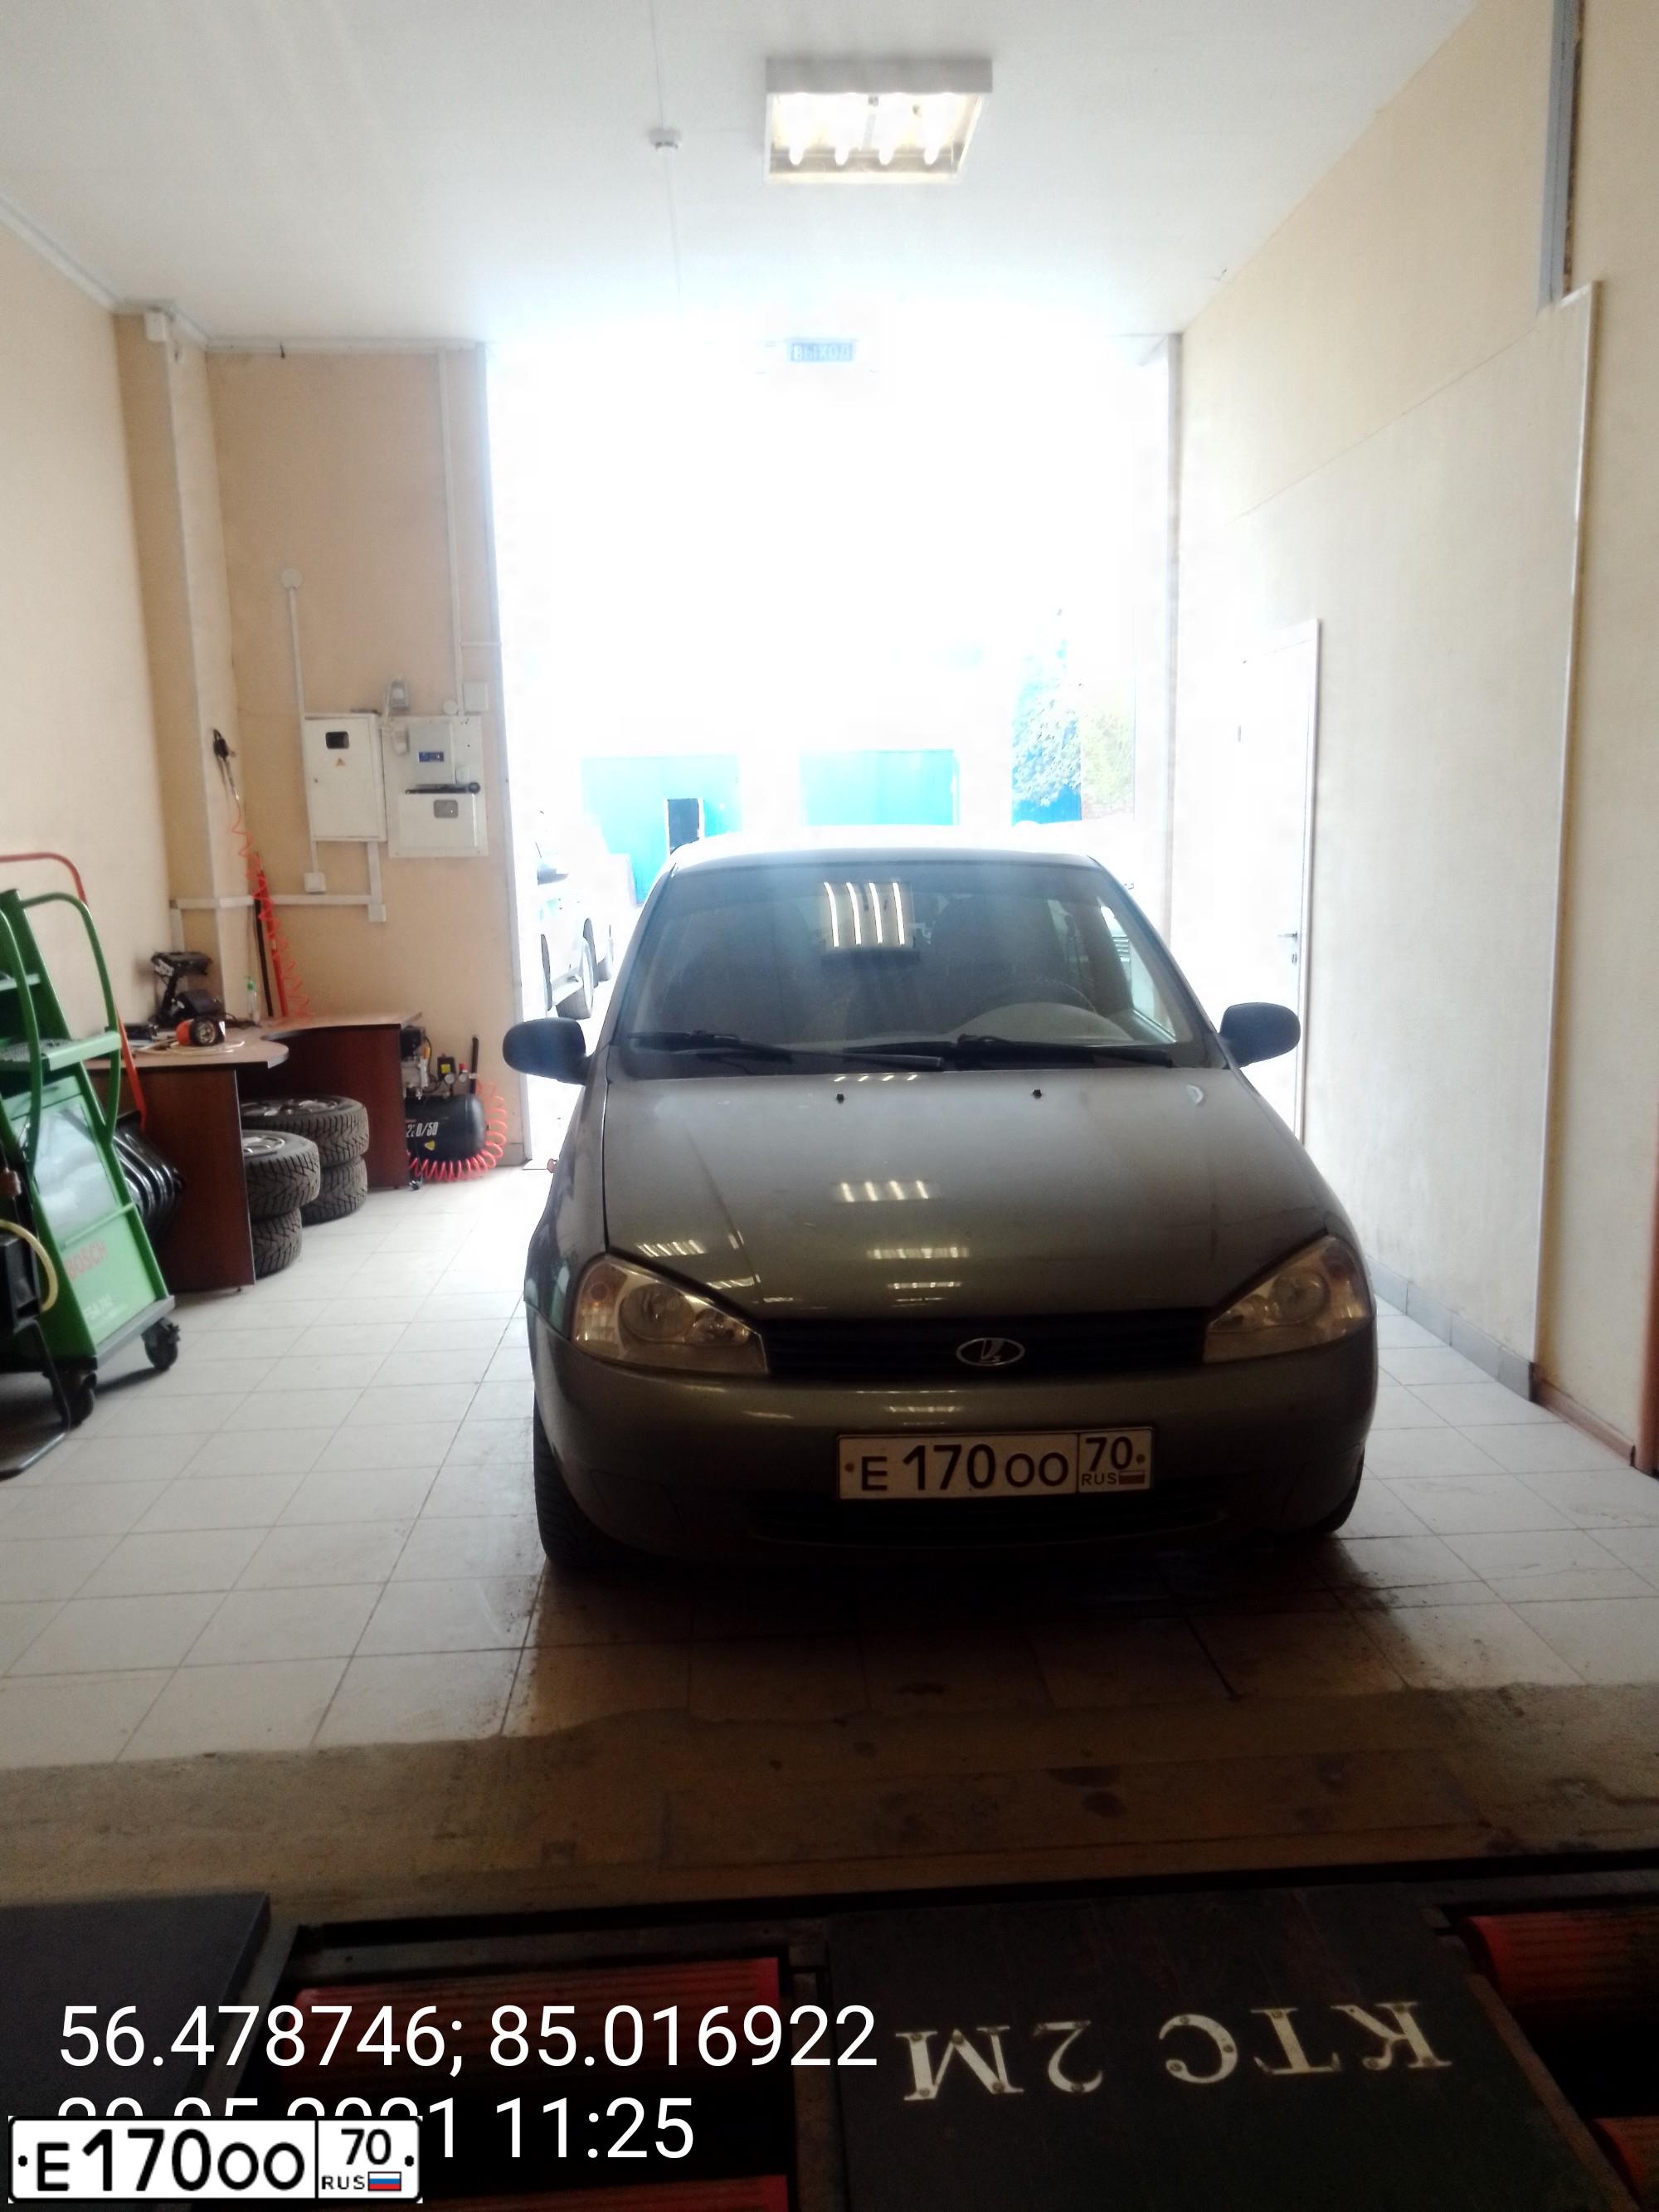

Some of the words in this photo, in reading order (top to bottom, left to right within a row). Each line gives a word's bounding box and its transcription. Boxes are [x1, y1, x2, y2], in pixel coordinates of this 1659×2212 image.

[792, 343, 851, 360] ВЫХОД
[1085, 1436, 1133, 1472] 70
[1082, 1472, 1117, 1486] RUS
